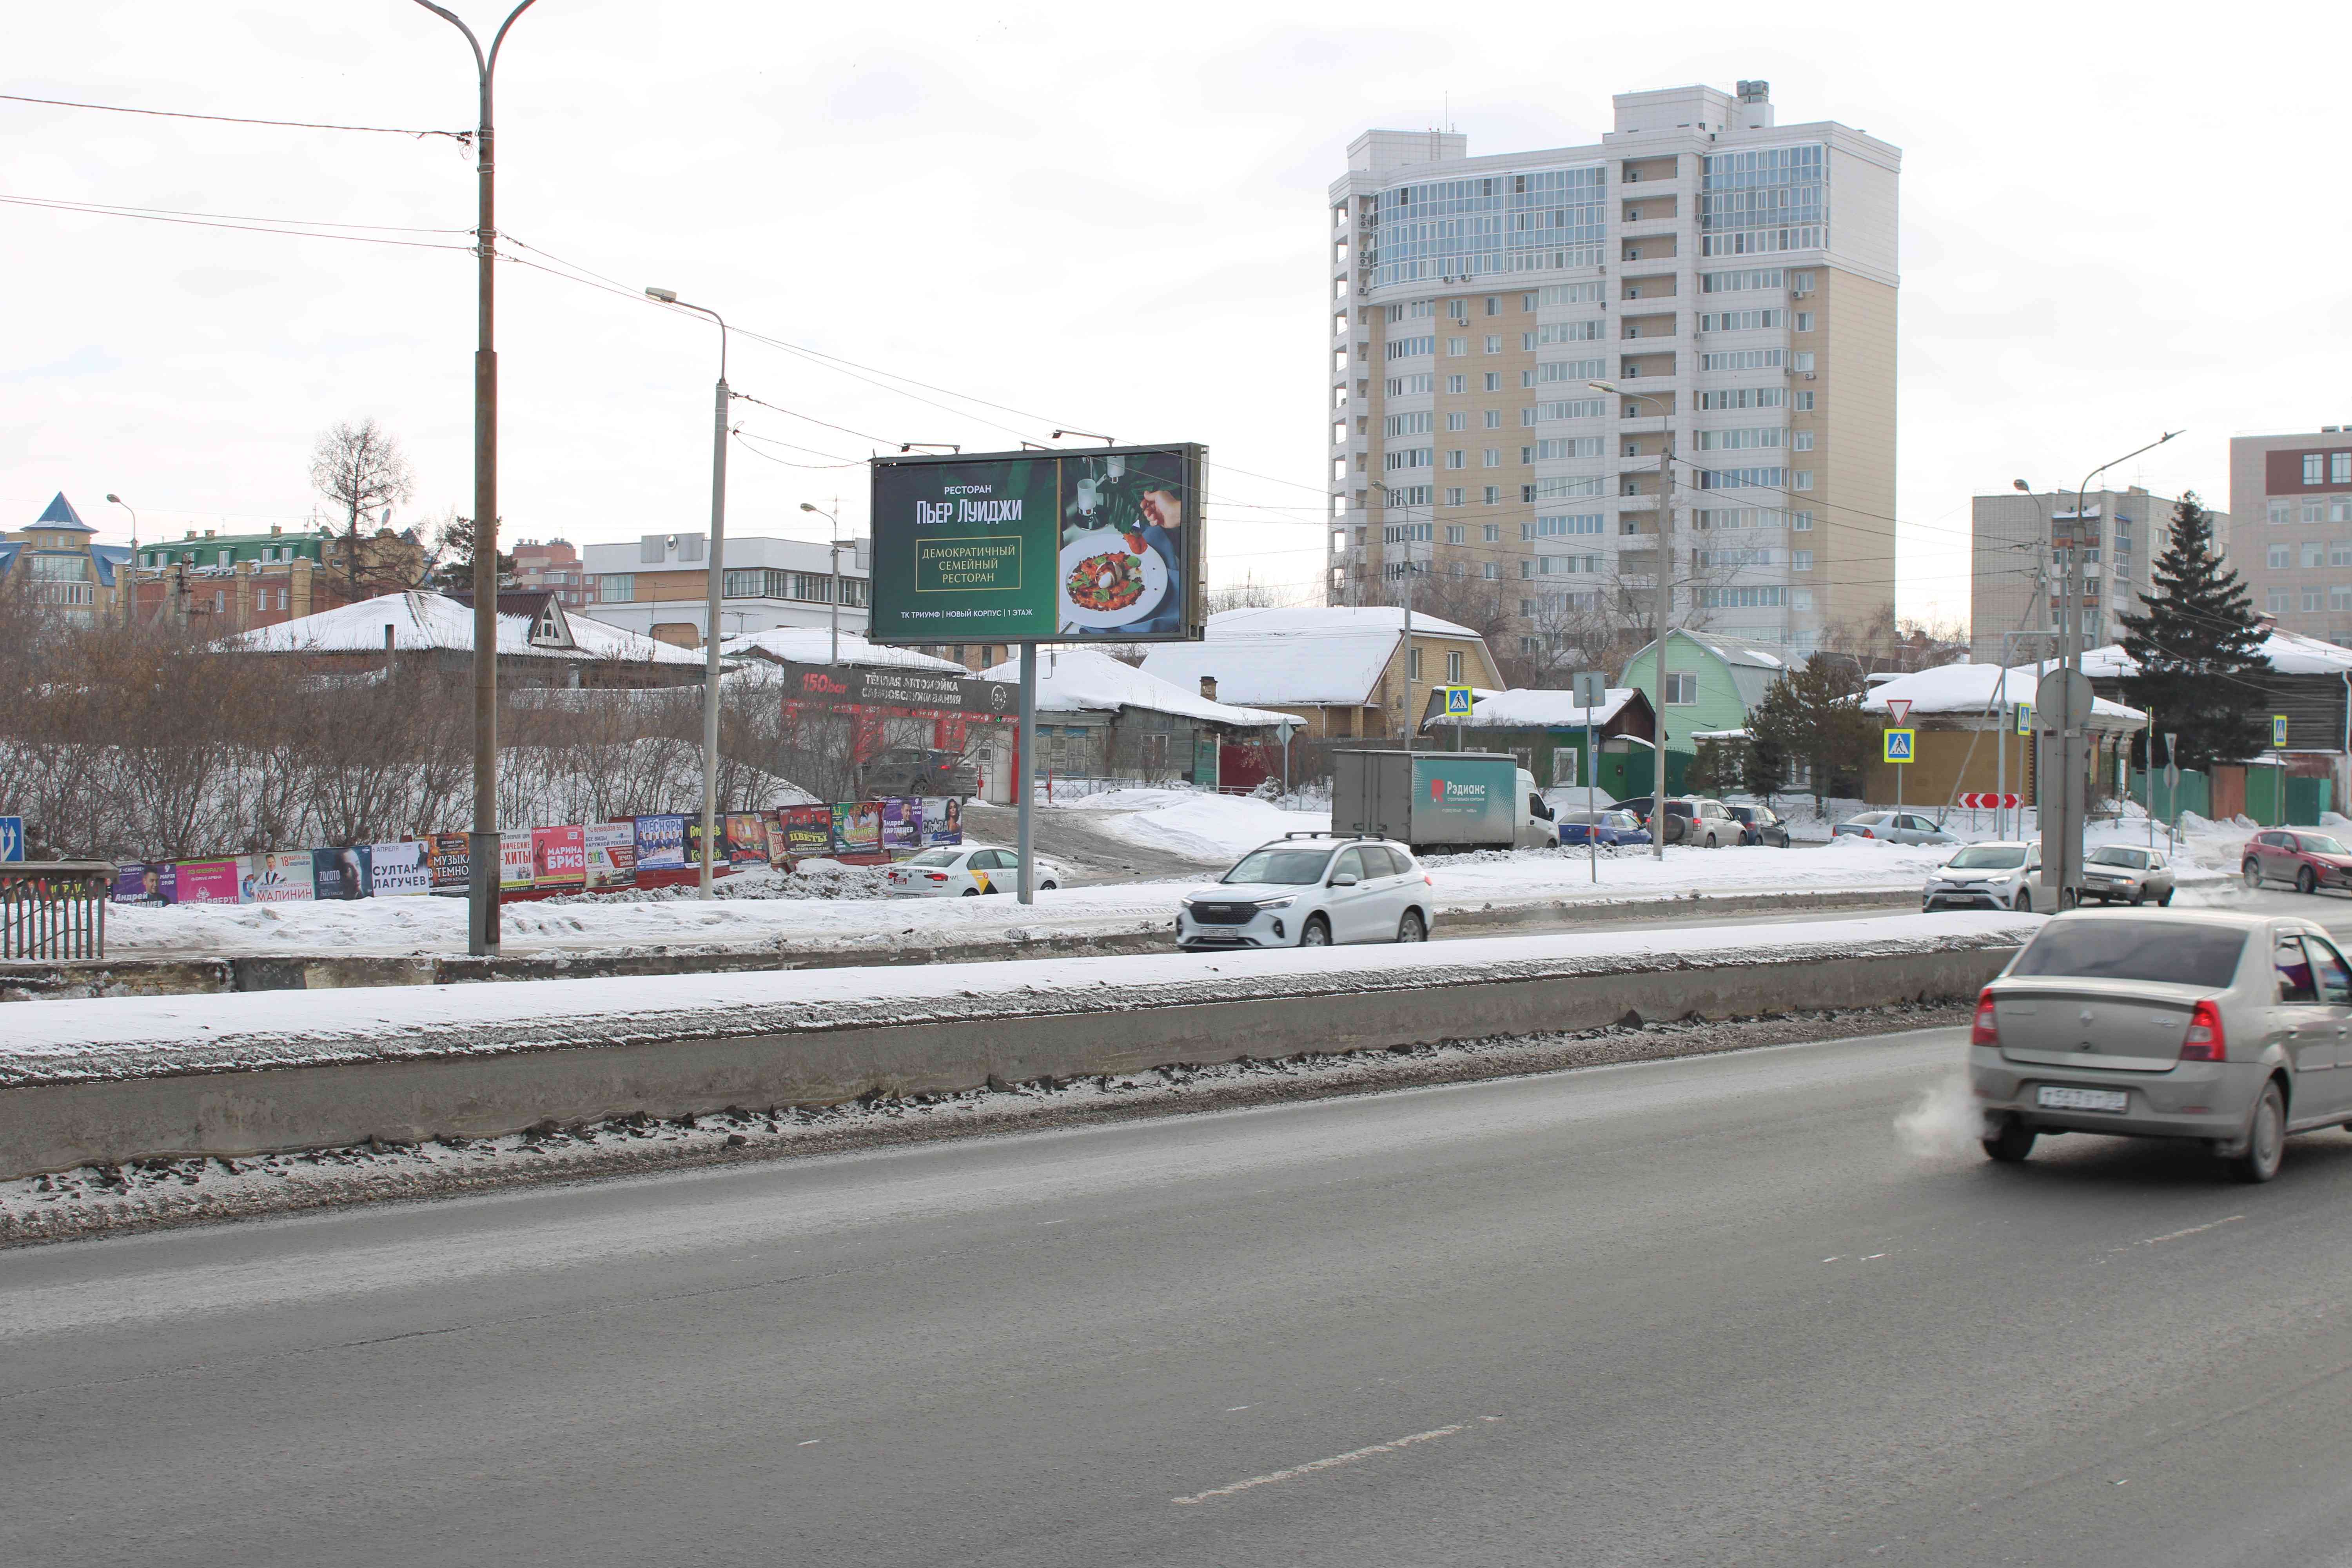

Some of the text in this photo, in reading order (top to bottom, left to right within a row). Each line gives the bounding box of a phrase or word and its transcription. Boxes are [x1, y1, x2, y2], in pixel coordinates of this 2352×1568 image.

[944, 485, 992, 495] РЕСТОРАН
[922, 544, 1015, 559] ДЕМОКРАТИЧНЫЙ
[938, 558, 998, 570] СЕМЕЙНЫЙ
[942, 573, 995, 583] РЕСТОРАН
[946, 608, 972, 618] НОВЫЙ
[865, 672, 959, 692] ТЁПЛАЯ АВТОМОЙКА
[1447, 781, 1485, 796] Рэдианс
[643, 818, 683, 833] ПЕСНЯРЫ
[789, 833, 828, 842] ЦВЕТЫ
[547, 846, 583, 855] МАРИНА
[280, 856, 289, 866] 18
[501, 851, 531, 865] -ХИТЫ
[547, 854, 584, 869] БРИЗ
[373, 864, 418, 876] СУЛТАН
[428, 865, 469, 878] В ТЕМНО
[374, 876, 426, 889] ЛАГУЧЕВ
[115, 891, 148, 902] Андрей
[257, 889, 312, 902] МАЛИНИН
